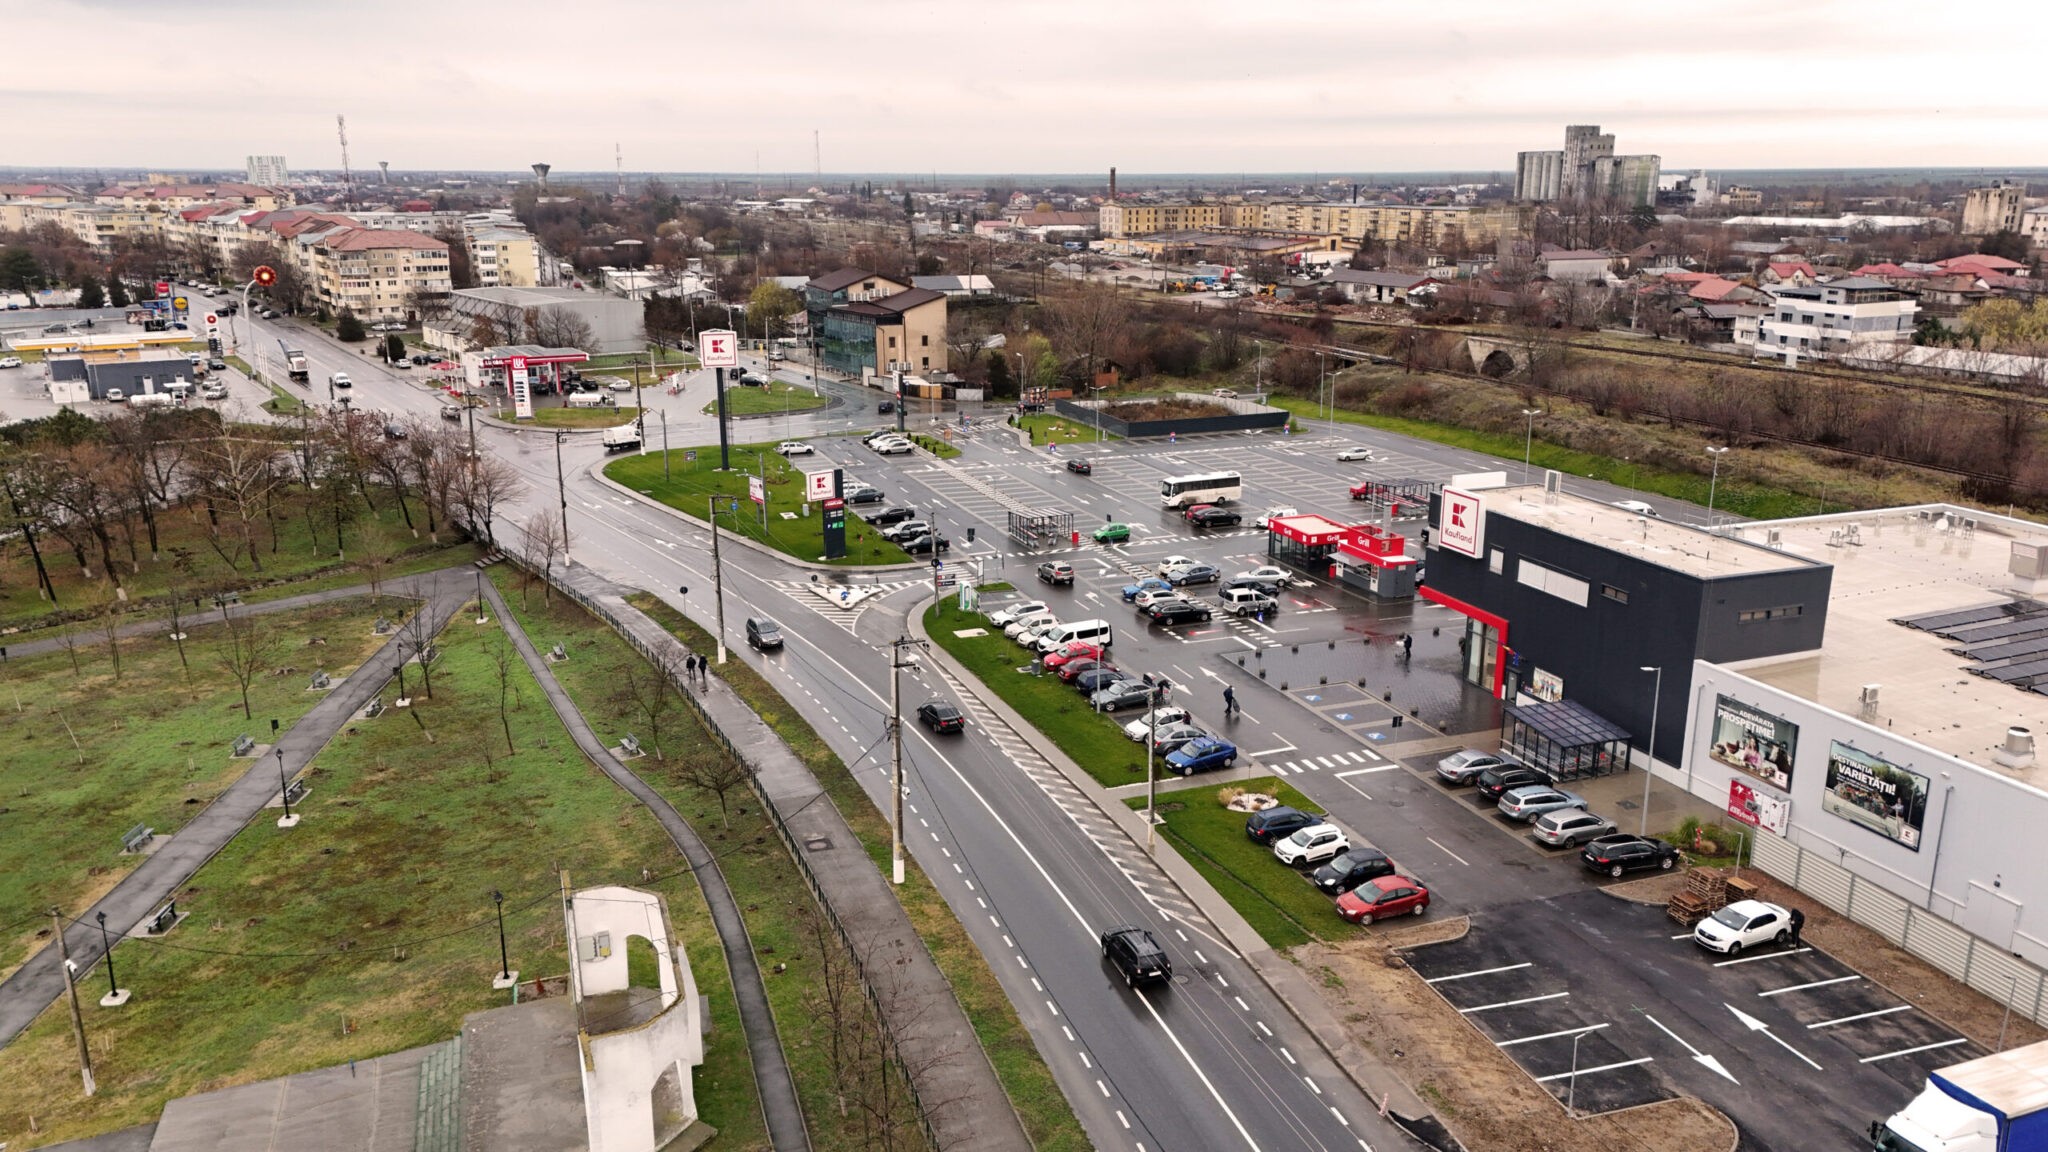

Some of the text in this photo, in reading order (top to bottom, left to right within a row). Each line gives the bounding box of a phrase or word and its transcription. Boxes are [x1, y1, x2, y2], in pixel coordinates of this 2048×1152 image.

[1358, 536, 1370, 548] Grill
[1445, 528, 1472, 543] Kaufland
[1838, 763, 1896, 795] VARIETĂȚII!
